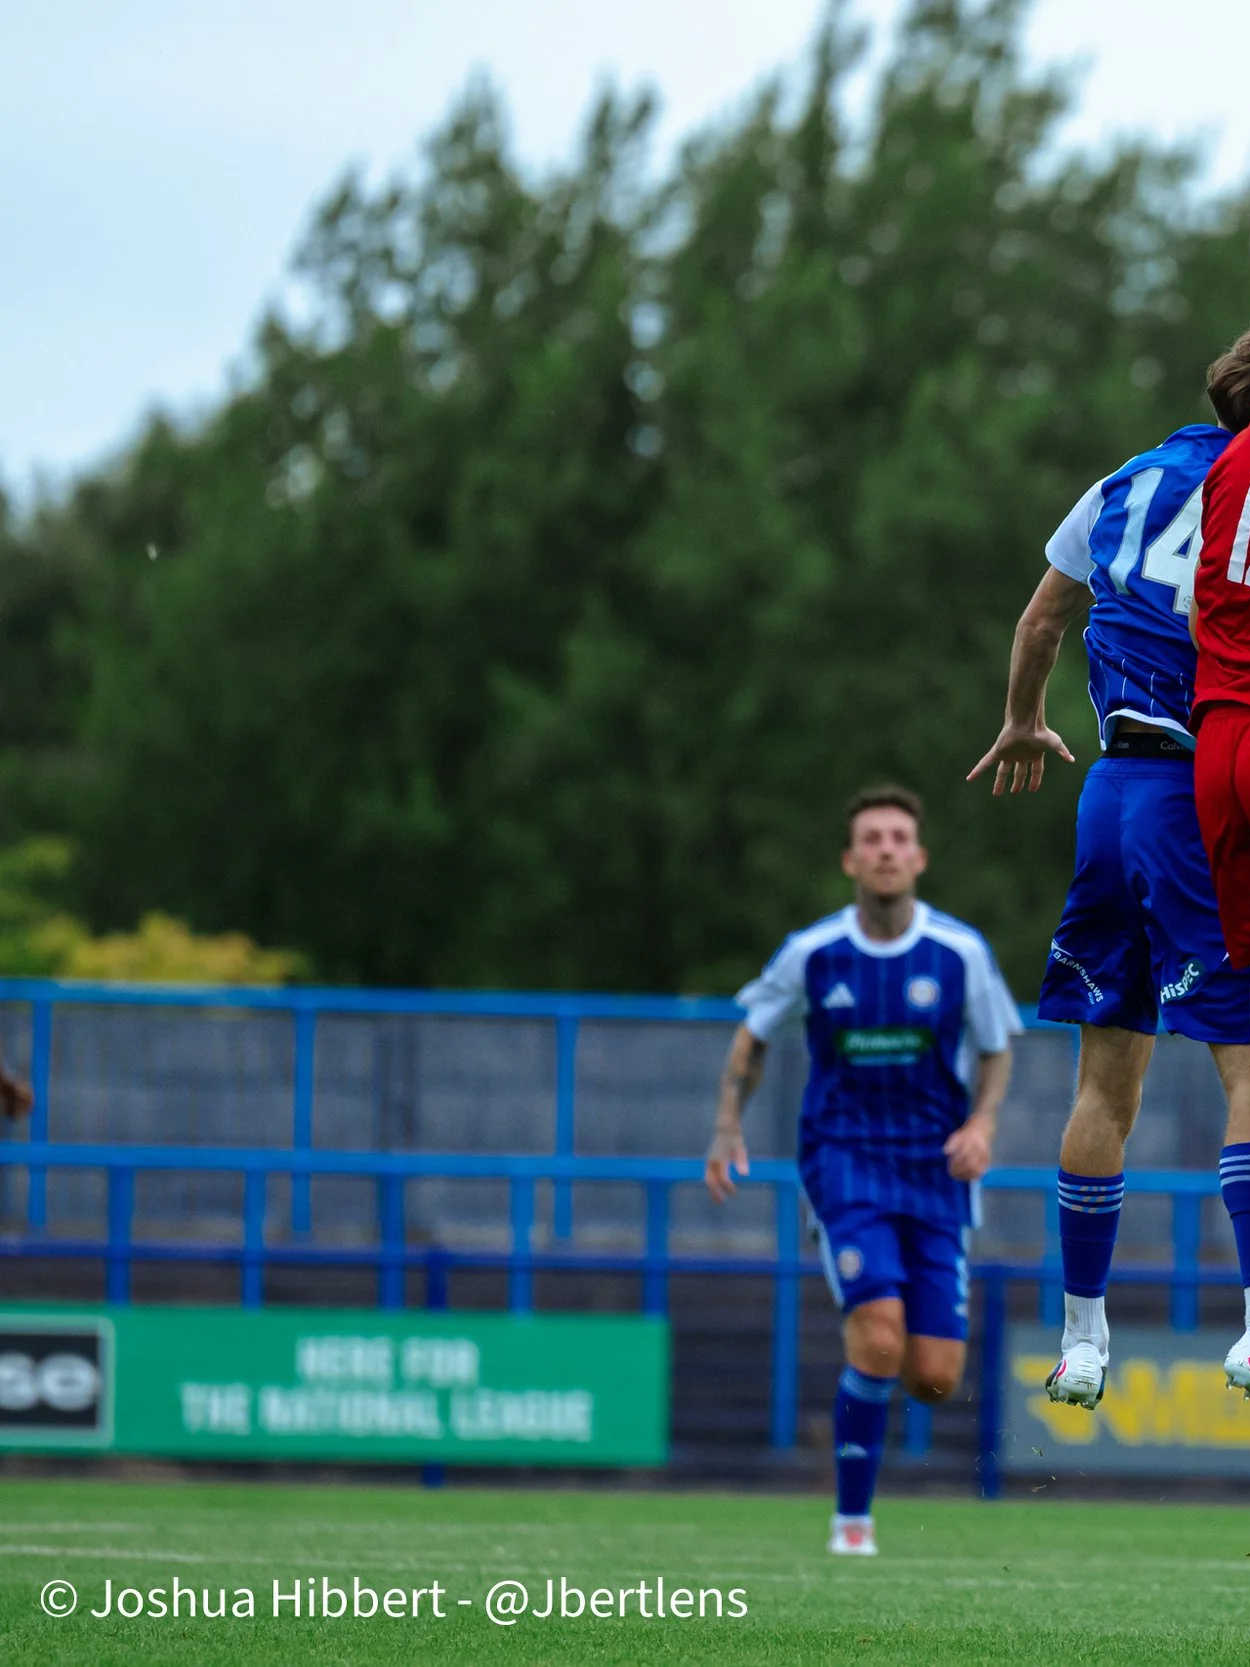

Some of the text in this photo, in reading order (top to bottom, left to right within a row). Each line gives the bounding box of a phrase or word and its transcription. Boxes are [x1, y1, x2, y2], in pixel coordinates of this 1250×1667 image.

[1108, 467, 1202, 616] 14
[1053, 951, 1104, 1002] BARNSHAWS
[402, 1338, 478, 1387] FOR
[182, 1383, 593, 1442] THE NATIONAL LEAGUE
